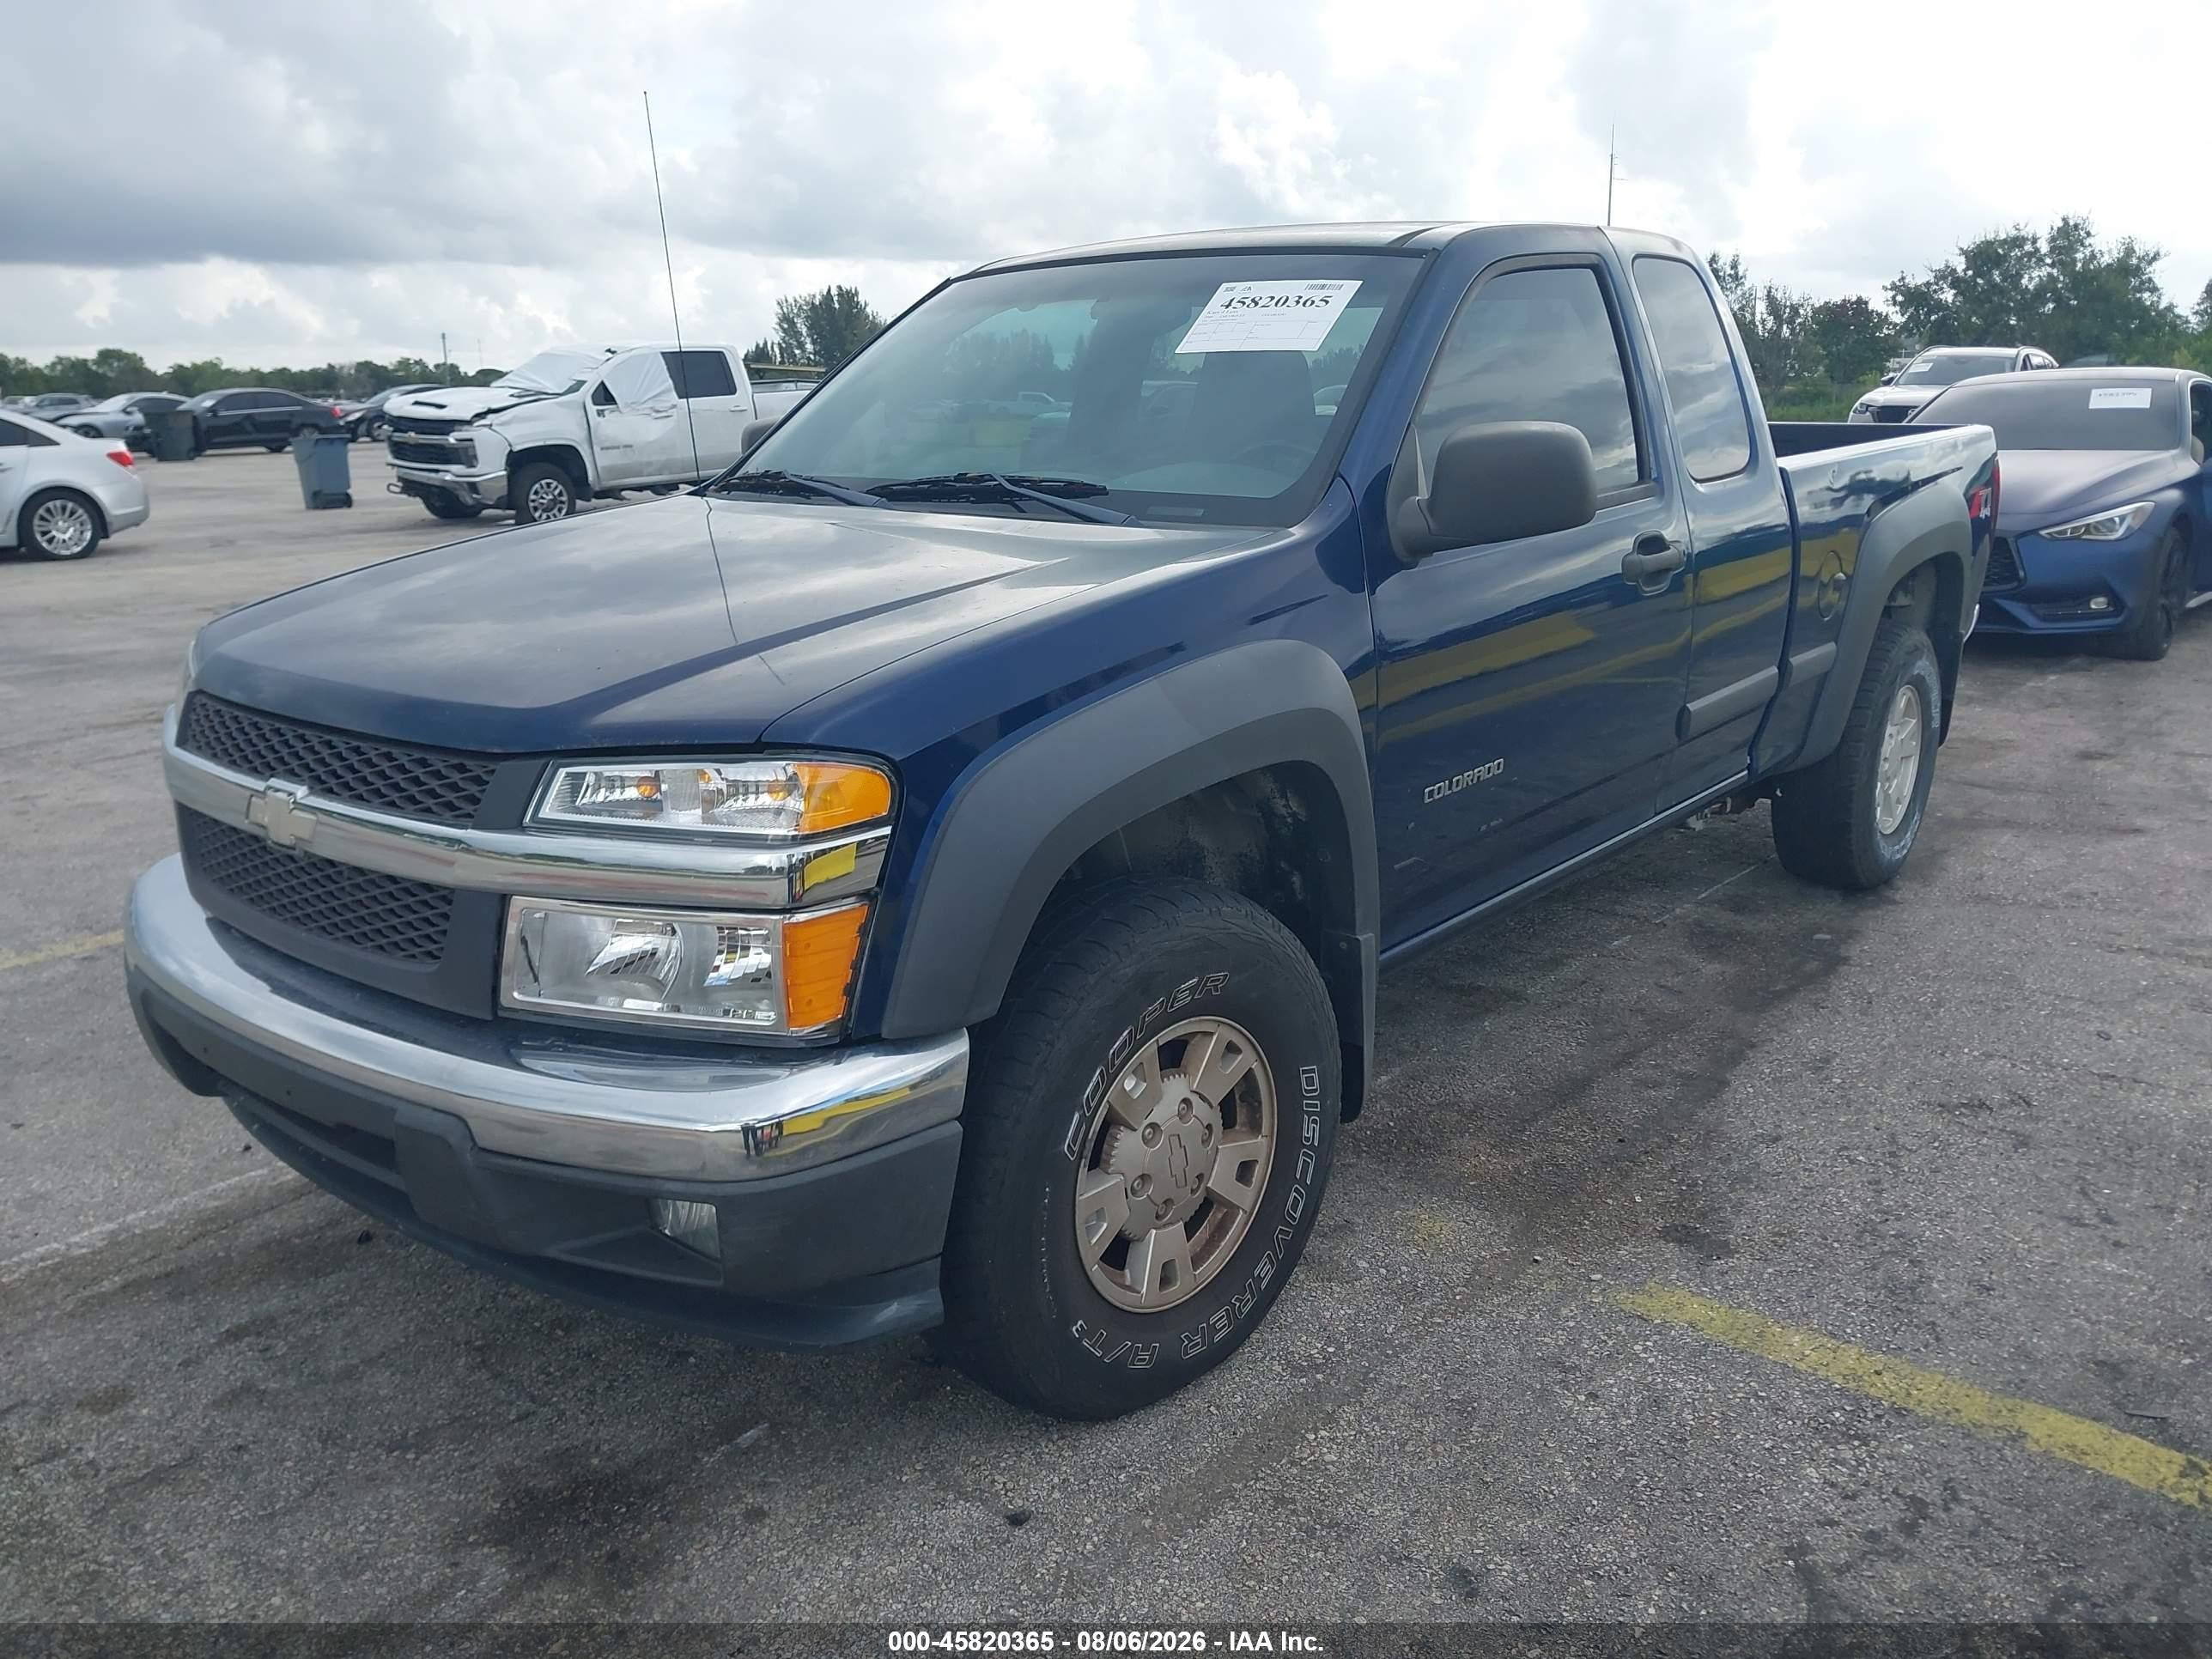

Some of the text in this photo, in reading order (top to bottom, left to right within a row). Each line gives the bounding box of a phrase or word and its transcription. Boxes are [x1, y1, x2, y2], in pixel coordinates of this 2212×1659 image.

[1220, 295, 1333, 309] 45820365
[1424, 758, 1504, 803] COLORADO
[1064, 972, 1231, 1160] COOPER
[1181, 1066, 1321, 1360] DISCOVERER
